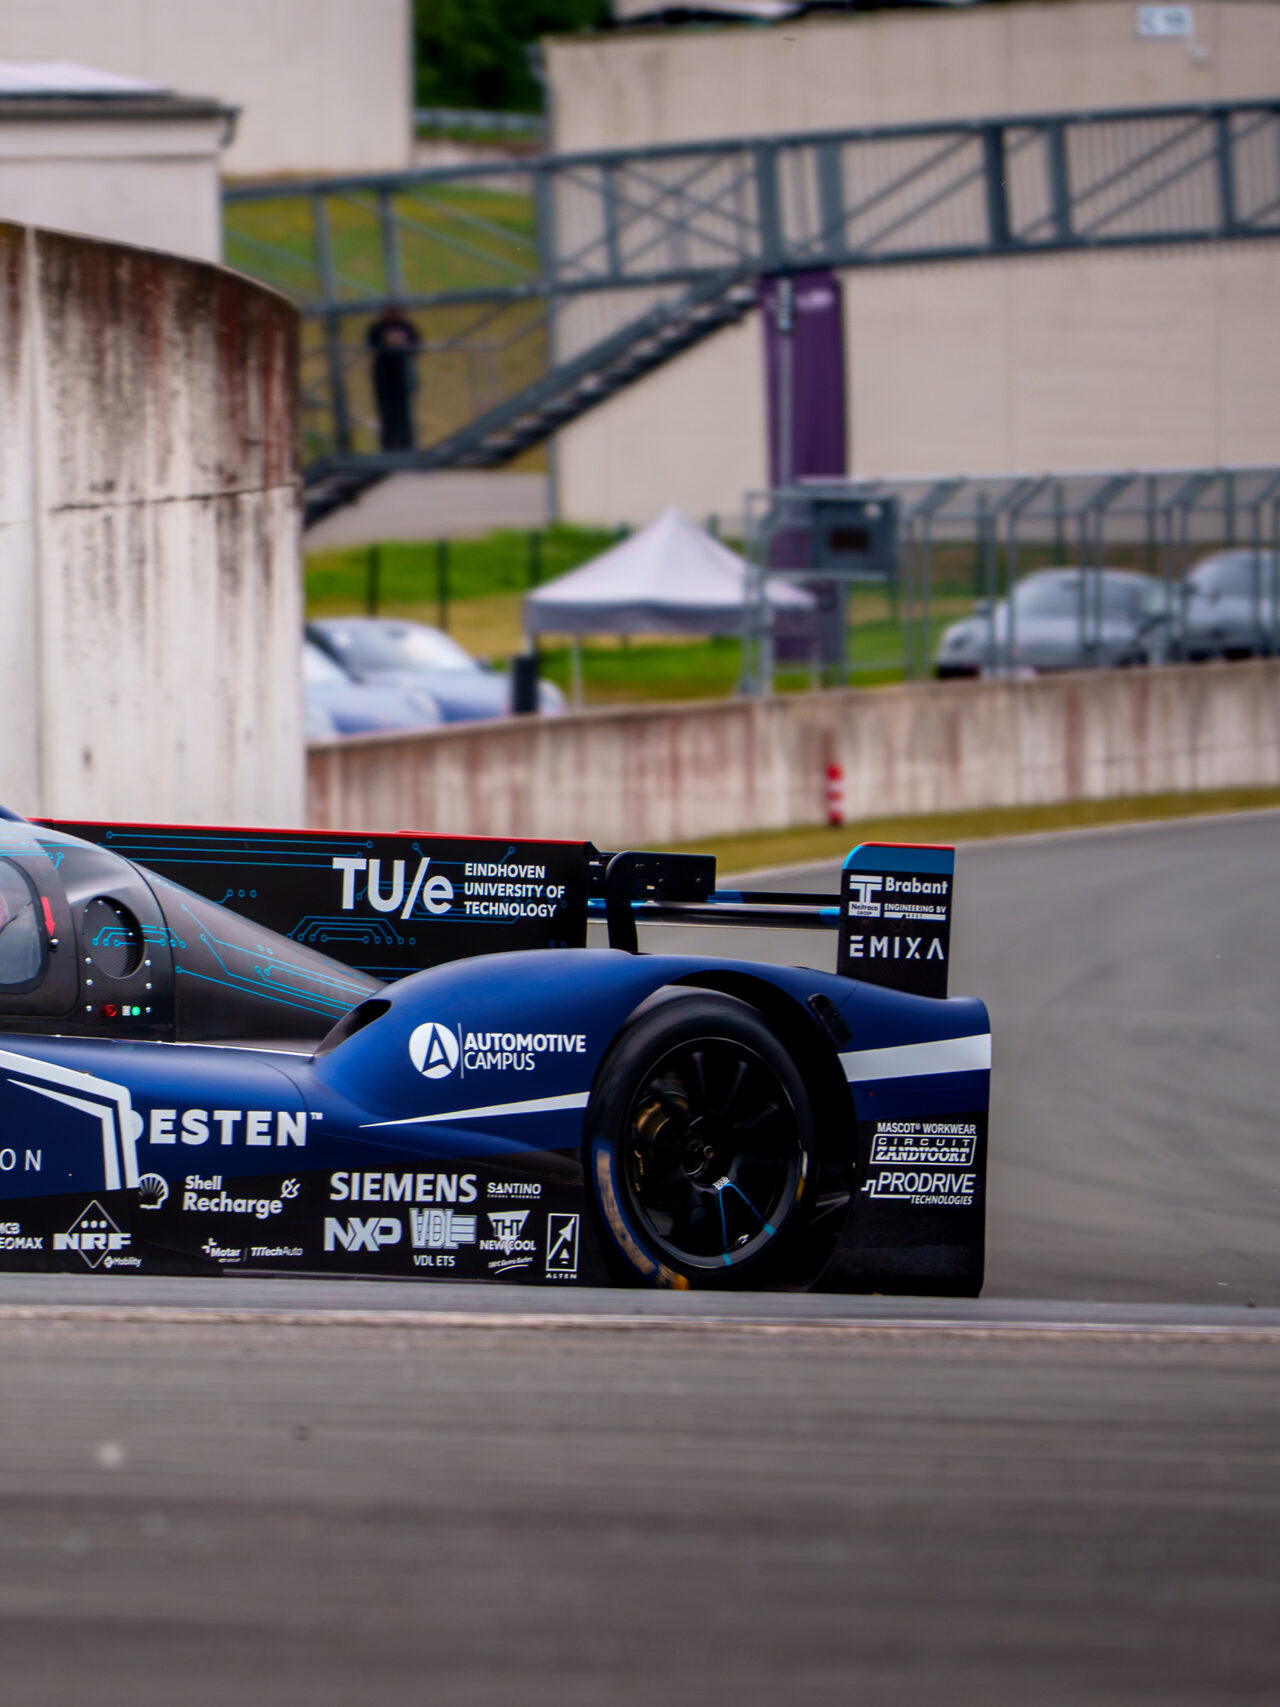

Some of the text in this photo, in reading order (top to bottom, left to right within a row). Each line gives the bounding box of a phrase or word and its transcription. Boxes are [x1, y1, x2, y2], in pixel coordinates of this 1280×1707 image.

[464, 863, 546, 879] EINDHOVEN
[332, 857, 455, 919] TU/e
[464, 882, 566, 899] UNIVERSITY OF
[885, 876, 948, 894] Brabant
[464, 901, 557, 917] TECHNOLOGY
[884, 903, 946, 913] ENGINEERING BV
[849, 935, 944, 960] EMIXA
[464, 1033, 586, 1053] AUTOMOTIVE
[464, 1052, 535, 1070] CAMPUS
[922, 1123, 977, 1134] WORKWEAR
[878, 1137, 971, 1147] CIRCUIT
[875, 1146, 970, 1162] ZANDVOORT
[184, 1174, 222, 1190] Shell
[329, 1172, 478, 1203] SIEMENS
[487, 1182, 542, 1194] SANTINO
[877, 1172, 976, 1193] PRODRIVE
[183, 1191, 283, 1219] Recharge
[911, 1195, 973, 1205] TECHNOLOGIES
[324, 1217, 402, 1251] NXP
[409, 1208, 460, 1249] VDL
[53, 1233, 132, 1251] NRF
[480, 1240, 506, 1251] NEW
[114, 1256, 142, 1267] Mobility
[413, 1254, 455, 1267] VDL ETS
[545, 1272, 578, 1280] ALTEN
